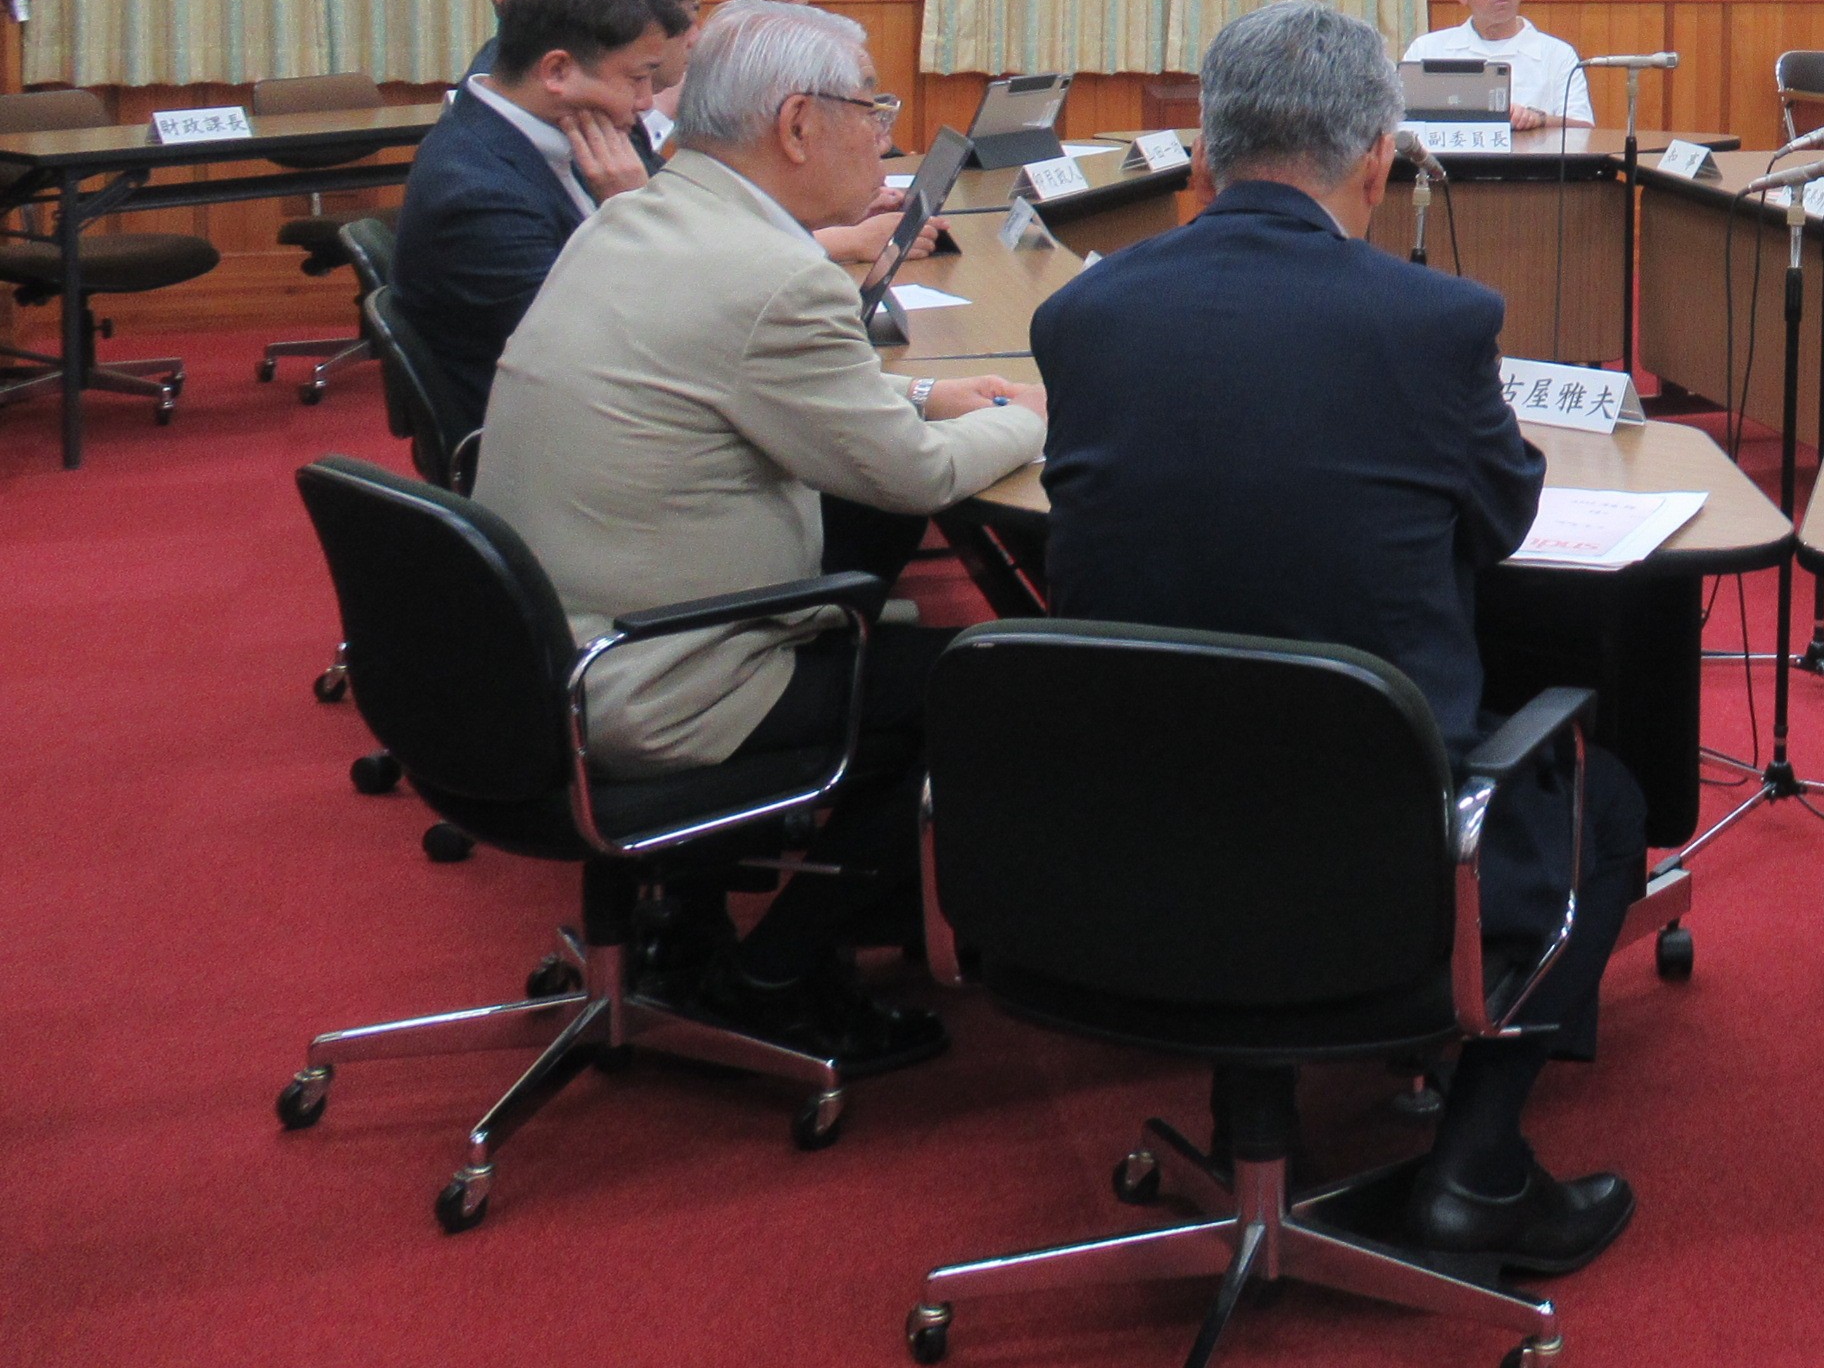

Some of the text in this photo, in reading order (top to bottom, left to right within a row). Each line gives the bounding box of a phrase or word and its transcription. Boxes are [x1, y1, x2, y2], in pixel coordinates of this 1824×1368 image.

[160, 113, 247, 135] 財政課長
[1428, 131, 1509, 148] 副委員長
[1502, 373, 1615, 420] 古屋雅夫
